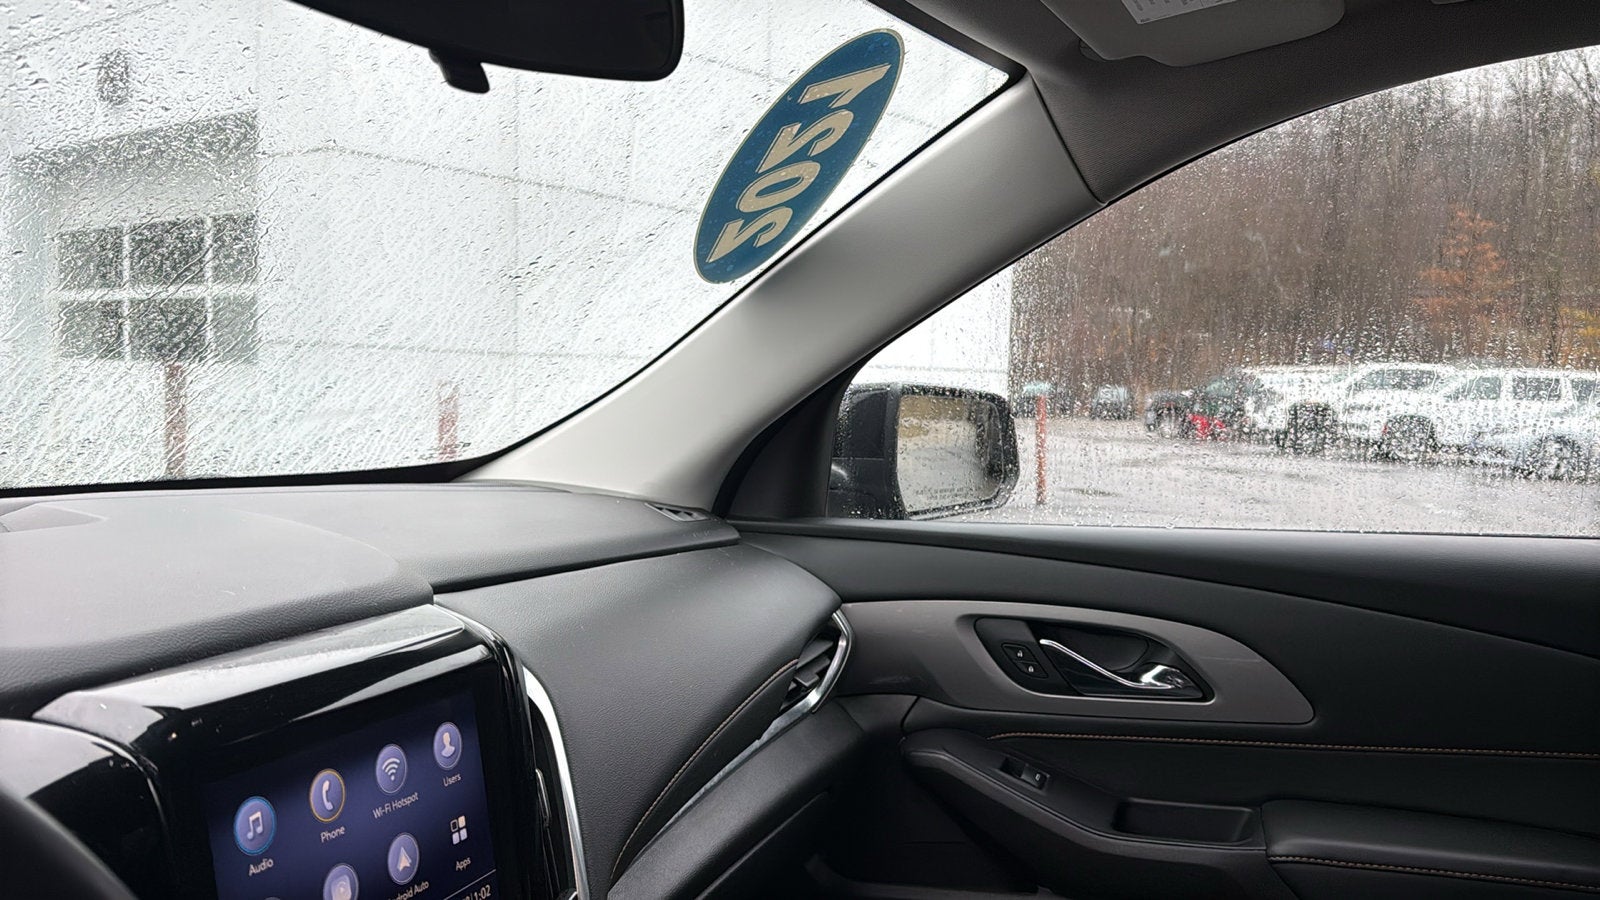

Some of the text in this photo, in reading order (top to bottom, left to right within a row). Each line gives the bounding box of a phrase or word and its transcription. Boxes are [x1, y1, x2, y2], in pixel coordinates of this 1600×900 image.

[443, 774, 461, 787] Users
[373, 792, 419, 819] Wi-Fi Hotspot
[320, 826, 345, 843] Phone
[248, 858, 274, 876] Audio
[455, 857, 471, 871] Apps
[414, 881, 430, 895] Auto
